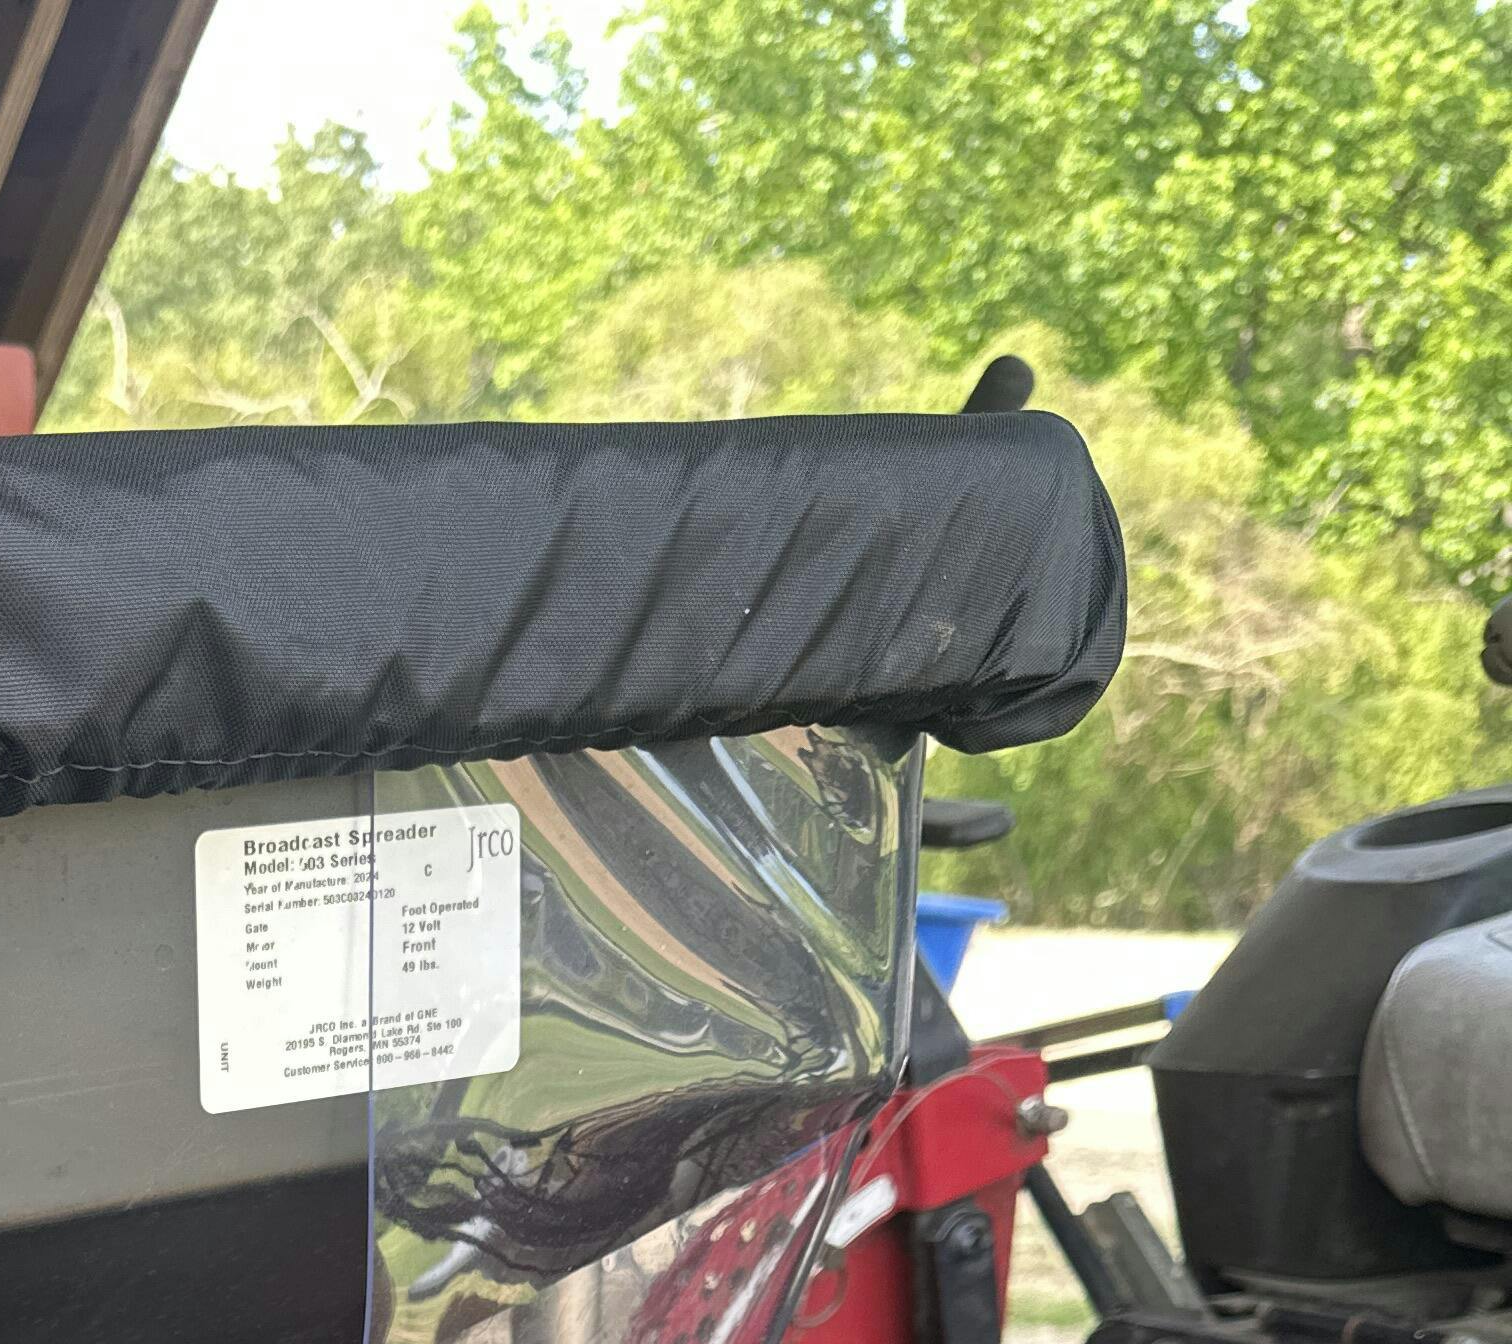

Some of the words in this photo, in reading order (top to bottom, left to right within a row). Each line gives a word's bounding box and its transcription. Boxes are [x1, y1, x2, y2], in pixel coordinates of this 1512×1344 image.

[244, 832, 340, 856] Broadcast
[349, 825, 436, 847] Spreader
[244, 858, 295, 876] Model:
[330, 852, 376, 868] Series
[424, 864, 432, 877] C
[244, 881, 268, 895] Year
[271, 881, 281, 893] of
[244, 901, 274, 914] Serial
[402, 904, 426, 917] Foot
[430, 897, 479, 915] Operated
[245, 923, 269, 934] Gate
[402, 922, 415, 934] 12
[403, 938, 436, 953] Front
[402, 961, 415, 973] 49
[246, 977, 283, 990] Weight
[309, 1022, 336, 1034] JRCO
[372, 1012, 401, 1026] Brand
[382, 1027, 403, 1038] Lake
[372, 1040, 389, 1050] MN
[284, 1064, 330, 1077] Customer
